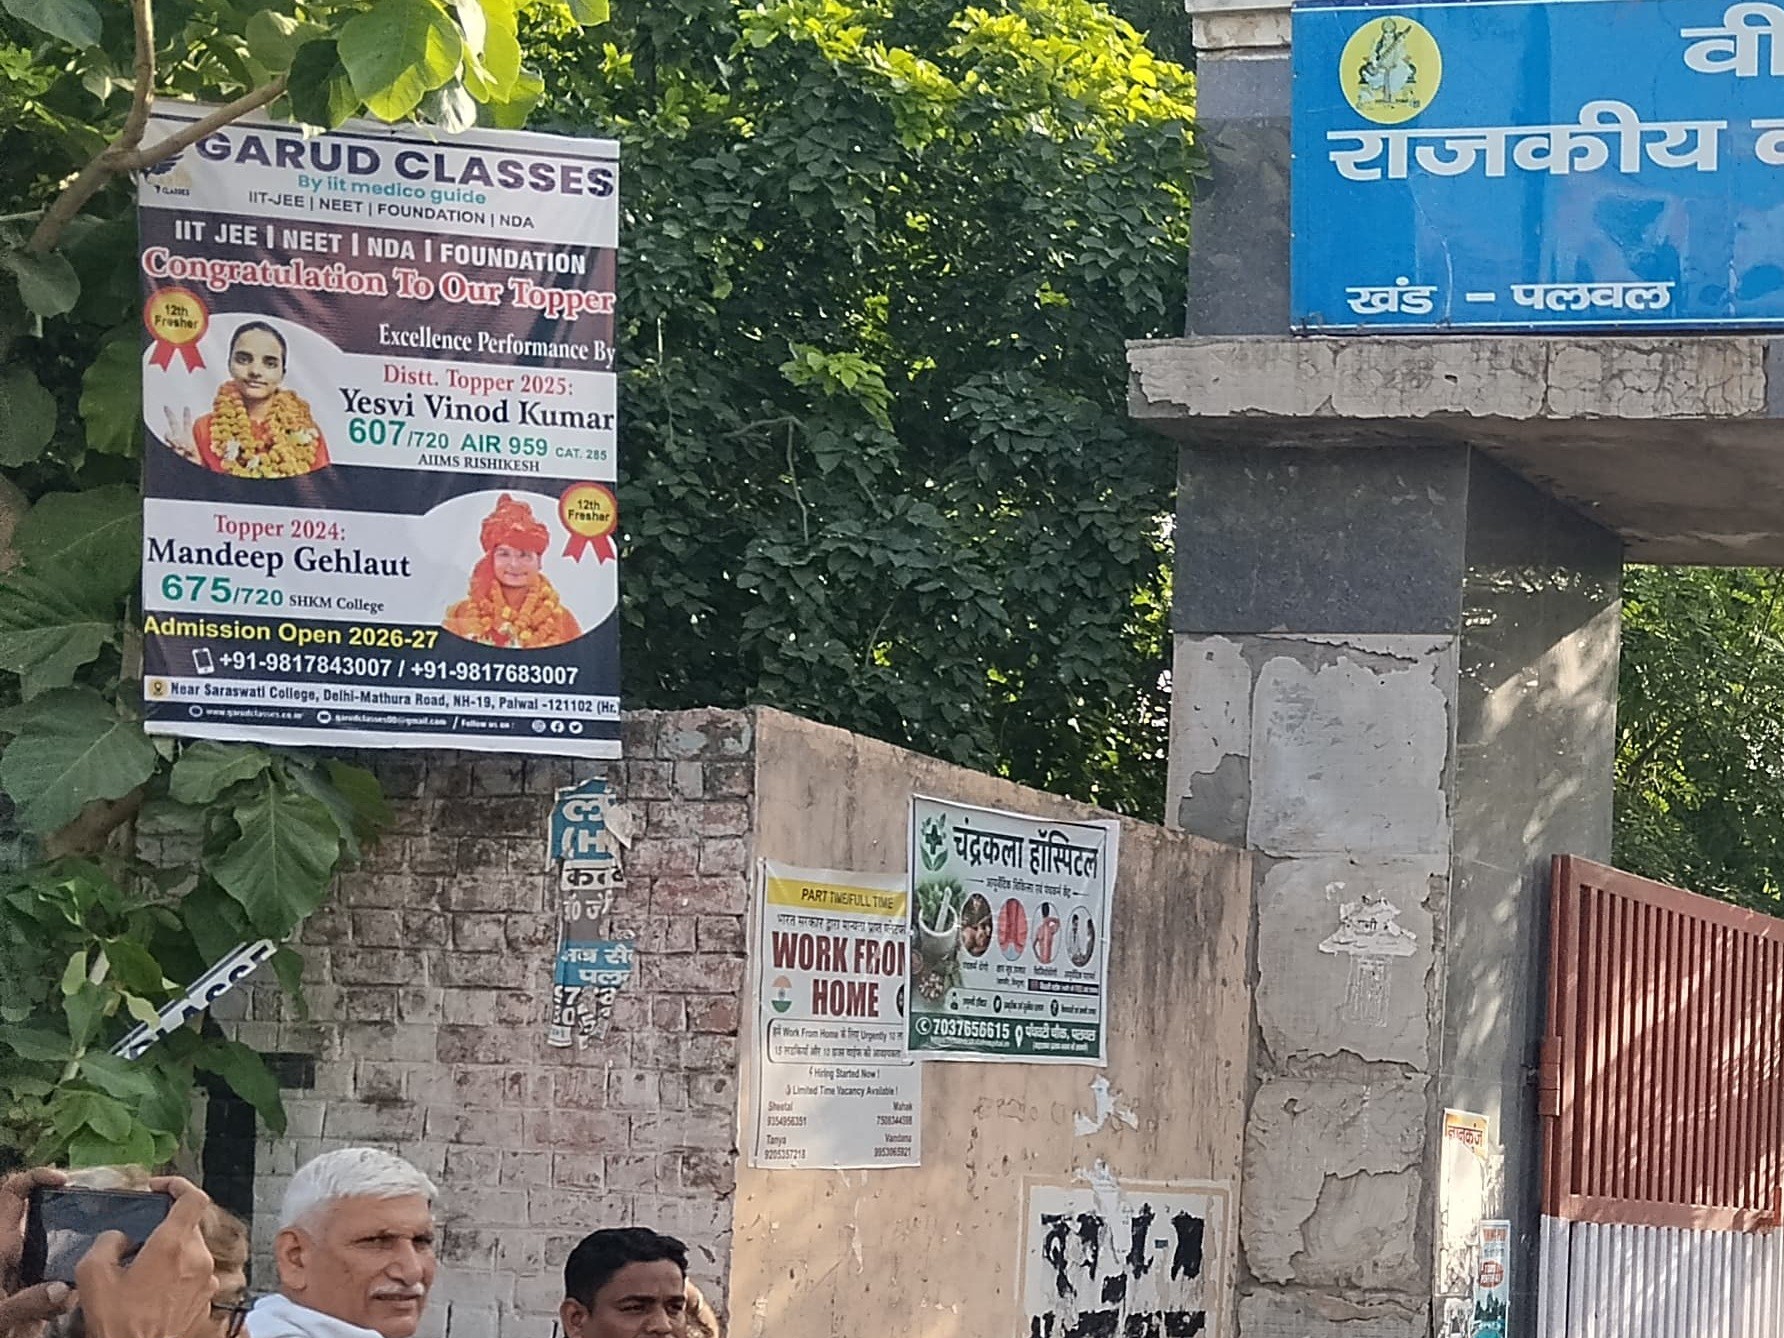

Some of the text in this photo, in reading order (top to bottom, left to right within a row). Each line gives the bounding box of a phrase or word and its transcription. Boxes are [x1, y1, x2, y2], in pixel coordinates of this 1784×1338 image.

[1327, 101, 1727, 182] राजकीय
[195, 131, 614, 198] GARUD CLASSES
[298, 174, 487, 206] By iit medico guide
[248, 191, 535, 229] IIT-JEE NEET FOUNDATION NDA
[175, 220, 585, 274] IIT JEE NEET NDA FOUNDATION
[142, 247, 615, 320] Congratulation To Our Topper
[1346, 276, 1437, 316] खंड
[1512, 281, 1676, 312] पलवल
[164, 303, 189, 318] 12th
[378, 323, 616, 367] Excellence Performance By
[384, 364, 574, 396] Distt. Topper 2025:
[339, 387, 615, 431] Yesvi Vinod Kumar
[348, 417, 607, 462] 607/720 AIR 959 CAT. 285
[417, 453, 540, 473] AIIMS RISHIKESH
[577, 498, 600, 511] 12th
[213, 514, 346, 542] Topper 2024:
[147, 537, 412, 577] Mandeep Gehlaut
[161, 573, 384, 614] 675/720 SHKM College
[143, 615, 439, 650] Admission Open 2026-27
[219, 649, 392, 678] +91-9817843007
[410, 660, 579, 686] +91-9817683007
[171, 682, 200, 695] Near
[204, 683, 265, 699] Saraswati
[269, 686, 319, 703] College,
[323, 688, 411, 706] Delhi-Mathura
[416, 693, 449, 708] Road,
[499, 697, 538, 710] Palwal
[952, 817, 1098, 879] चंद्रकला हॉस्पिटल
[801, 888, 828, 901] PART
[873, 896, 894, 909] TIME
[772, 931, 848, 973] WORK
[812, 978, 880, 1018] HOME
[782, 1026, 800, 1037] Work
[801, 1027, 818, 1038] From
[932, 1018, 1010, 1040] 7037656615
[793, 1085, 817, 1095] Limited
[820, 1085, 835, 1095] Time
[837, 1086, 864, 1097] Vacancy
[814, 1068, 875, 1080] Hiring Started Now
